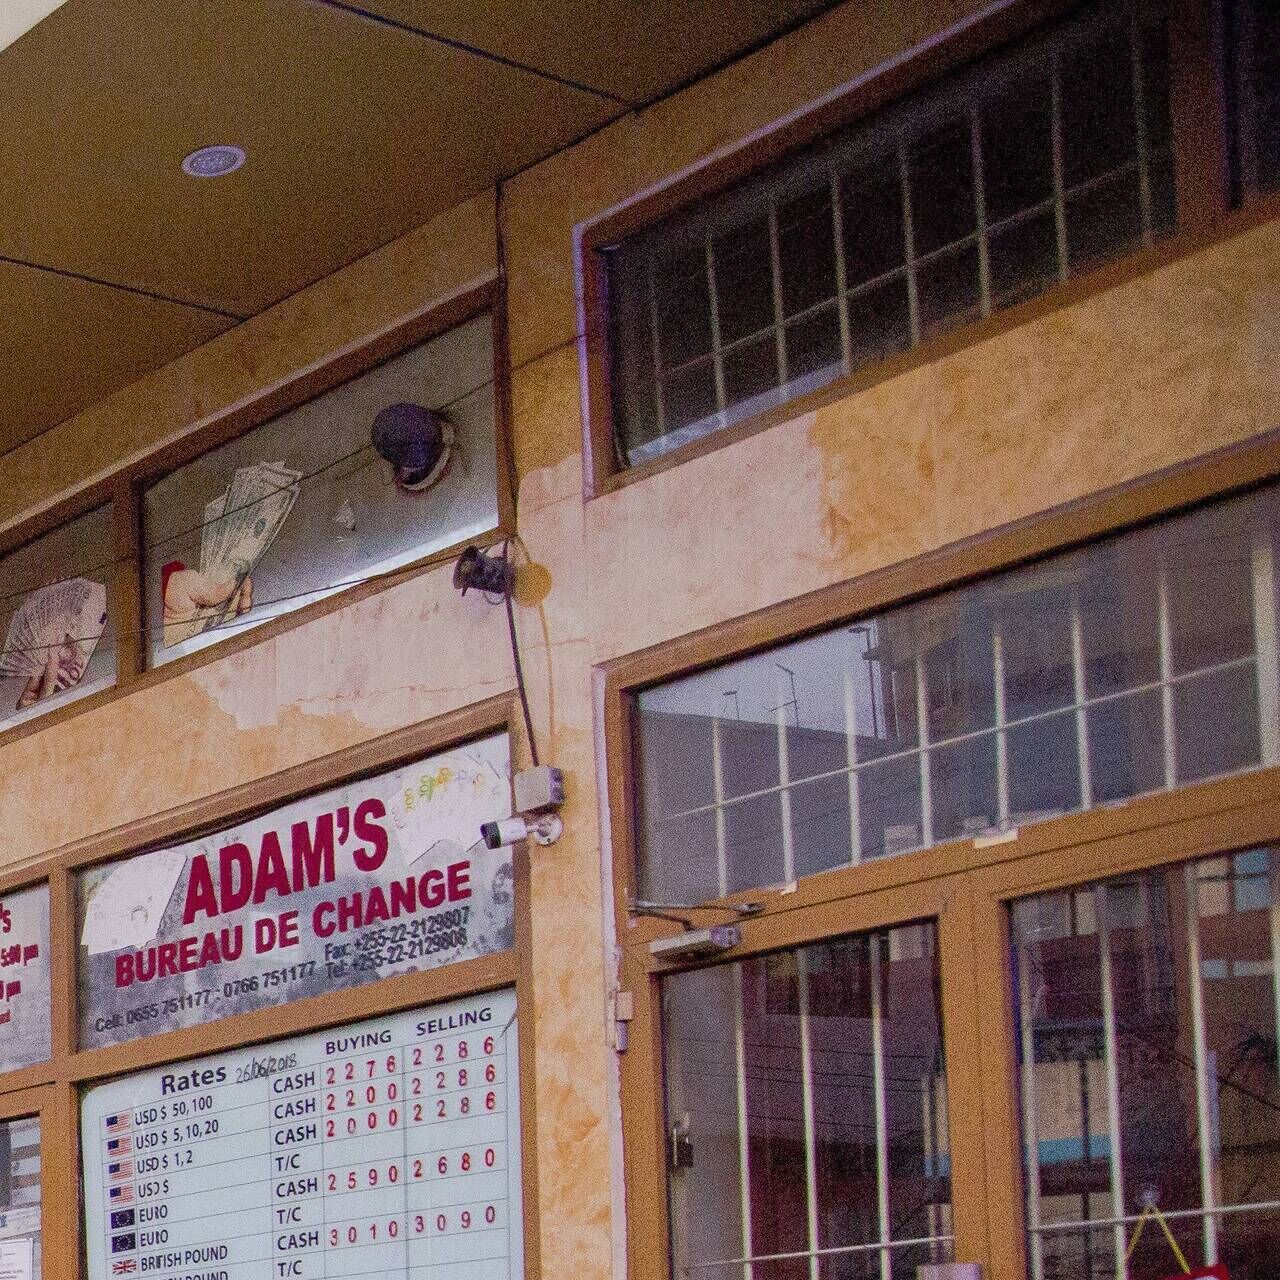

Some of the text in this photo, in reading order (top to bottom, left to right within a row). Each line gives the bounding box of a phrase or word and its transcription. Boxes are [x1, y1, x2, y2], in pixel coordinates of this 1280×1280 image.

[182, 798, 389, 925] ADAM'S
[114, 859, 472, 989] BUREAU DE CHANGE
[261, 961, 317, 988] 751177
[326, 1007, 492, 1055] BUYING SELLING
[162, 1066, 227, 1095] Rates
[135, 1109, 157, 1126] USD
[273, 1071, 315, 1093] CASH
[136, 1132, 158, 1150] USD
[274, 1098, 316, 1119] CASH
[137, 1157, 159, 1174] USD
[275, 1124, 317, 1145] CASH
[275, 1153, 300, 1172] T/C
[276, 1177, 318, 1198] CASH
[277, 1206, 302, 1224] T/C
[185, 1245, 228, 1265] POUND
[277, 1231, 319, 1251] CASH
[278, 1260, 302, 1277] T/C
